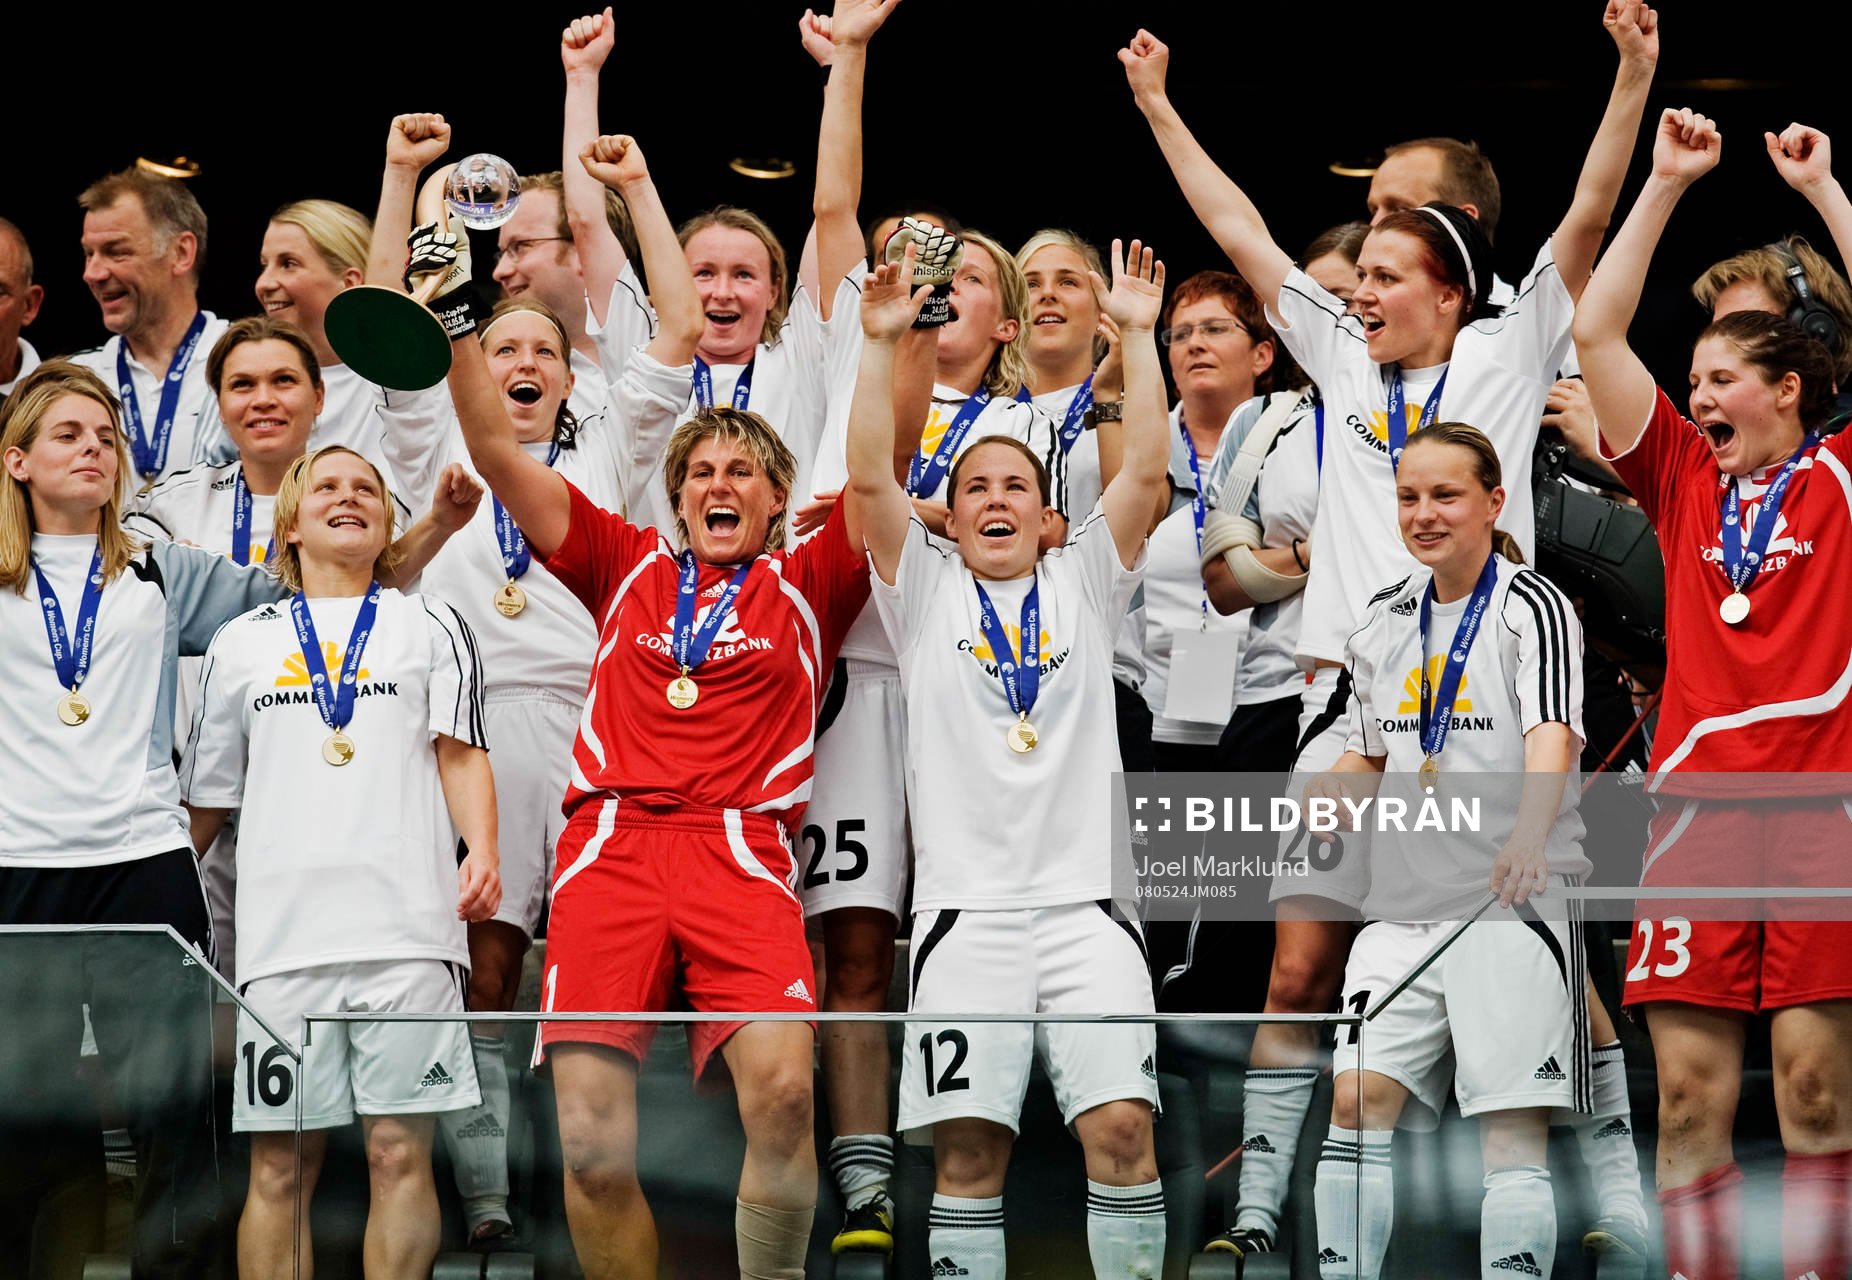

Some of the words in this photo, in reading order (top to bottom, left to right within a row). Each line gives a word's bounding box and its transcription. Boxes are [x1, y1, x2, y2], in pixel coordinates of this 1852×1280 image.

[47, 610, 59, 645] Women's
[1460, 612, 1479, 649] Women's
[79, 632, 90, 668] Women's
[802, 819, 869, 891] 25
[1626, 916, 1692, 982] 23
[242, 1041, 294, 1107] 16
[920, 1029, 970, 1097] 12
[1534, 1071, 1567, 1080] adidas
[421, 1076, 454, 1087] adidas
[456, 1127, 505, 1139] adidas
[1490, 1260, 1543, 1276] adidas
